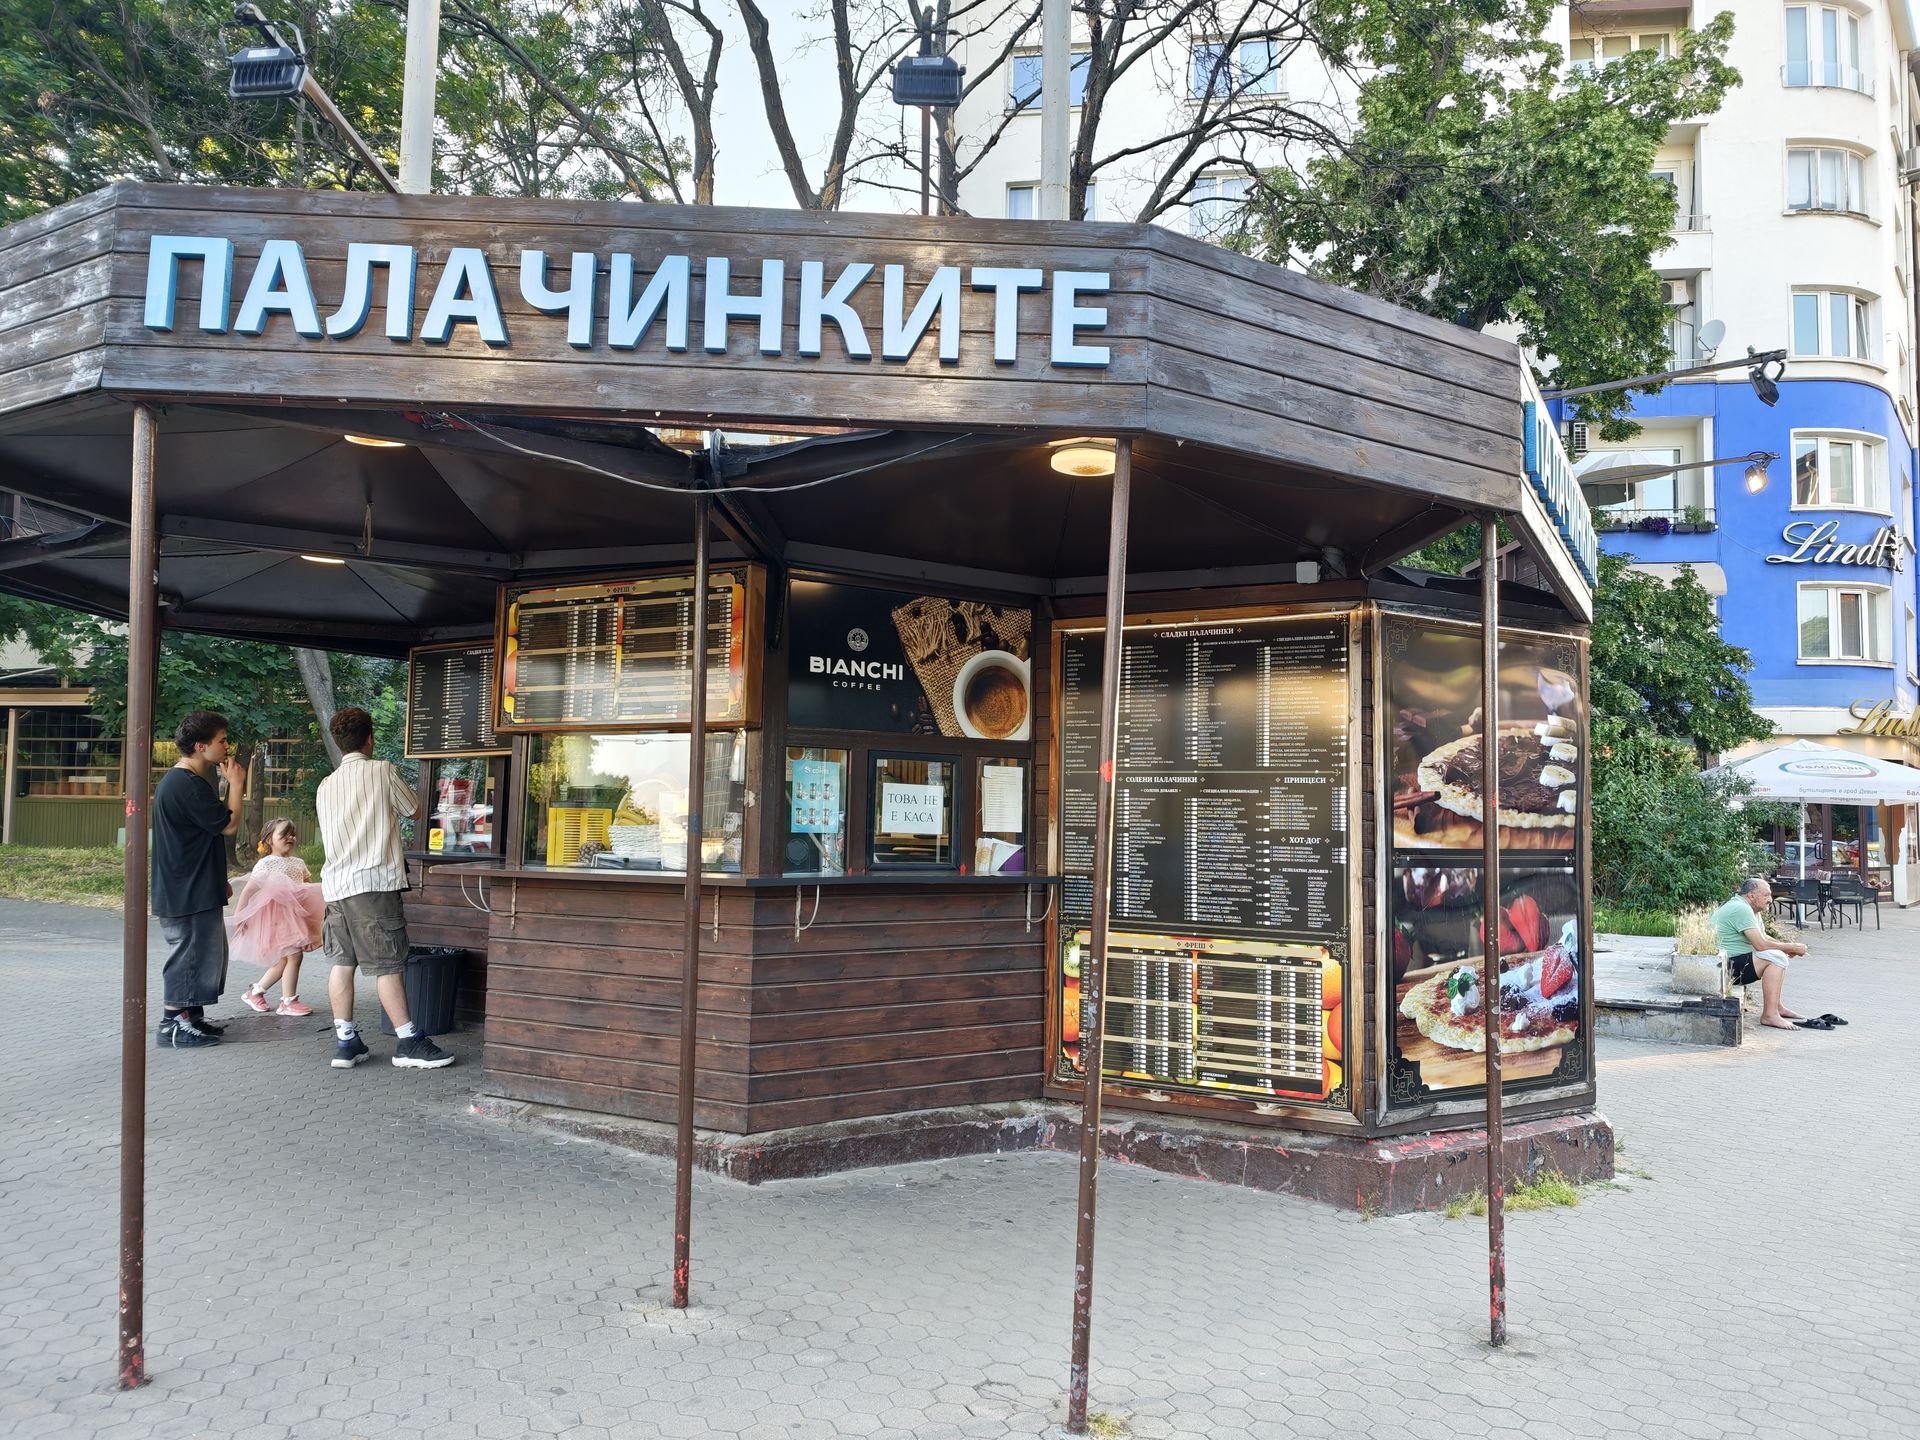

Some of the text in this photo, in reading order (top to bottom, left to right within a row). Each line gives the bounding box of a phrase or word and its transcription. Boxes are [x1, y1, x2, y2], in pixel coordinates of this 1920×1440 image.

[143, 235, 1111, 368] ПАЛАЧИНКИТЕ
[1765, 520, 1890, 567] Lindt
[1160, 628, 1234, 639] СЛАДКИ ПАЛАЧИНКИ
[809, 656, 904, 681] BIANCHI
[832, 680, 882, 691] COFFEE
[887, 793, 939, 806] ТОВА НЕ
[891, 811, 935, 823] Е КАСА
[1289, 836, 1322, 845] ХОТ-ДОГ
[1184, 941, 1206, 949] ФРЕШ
